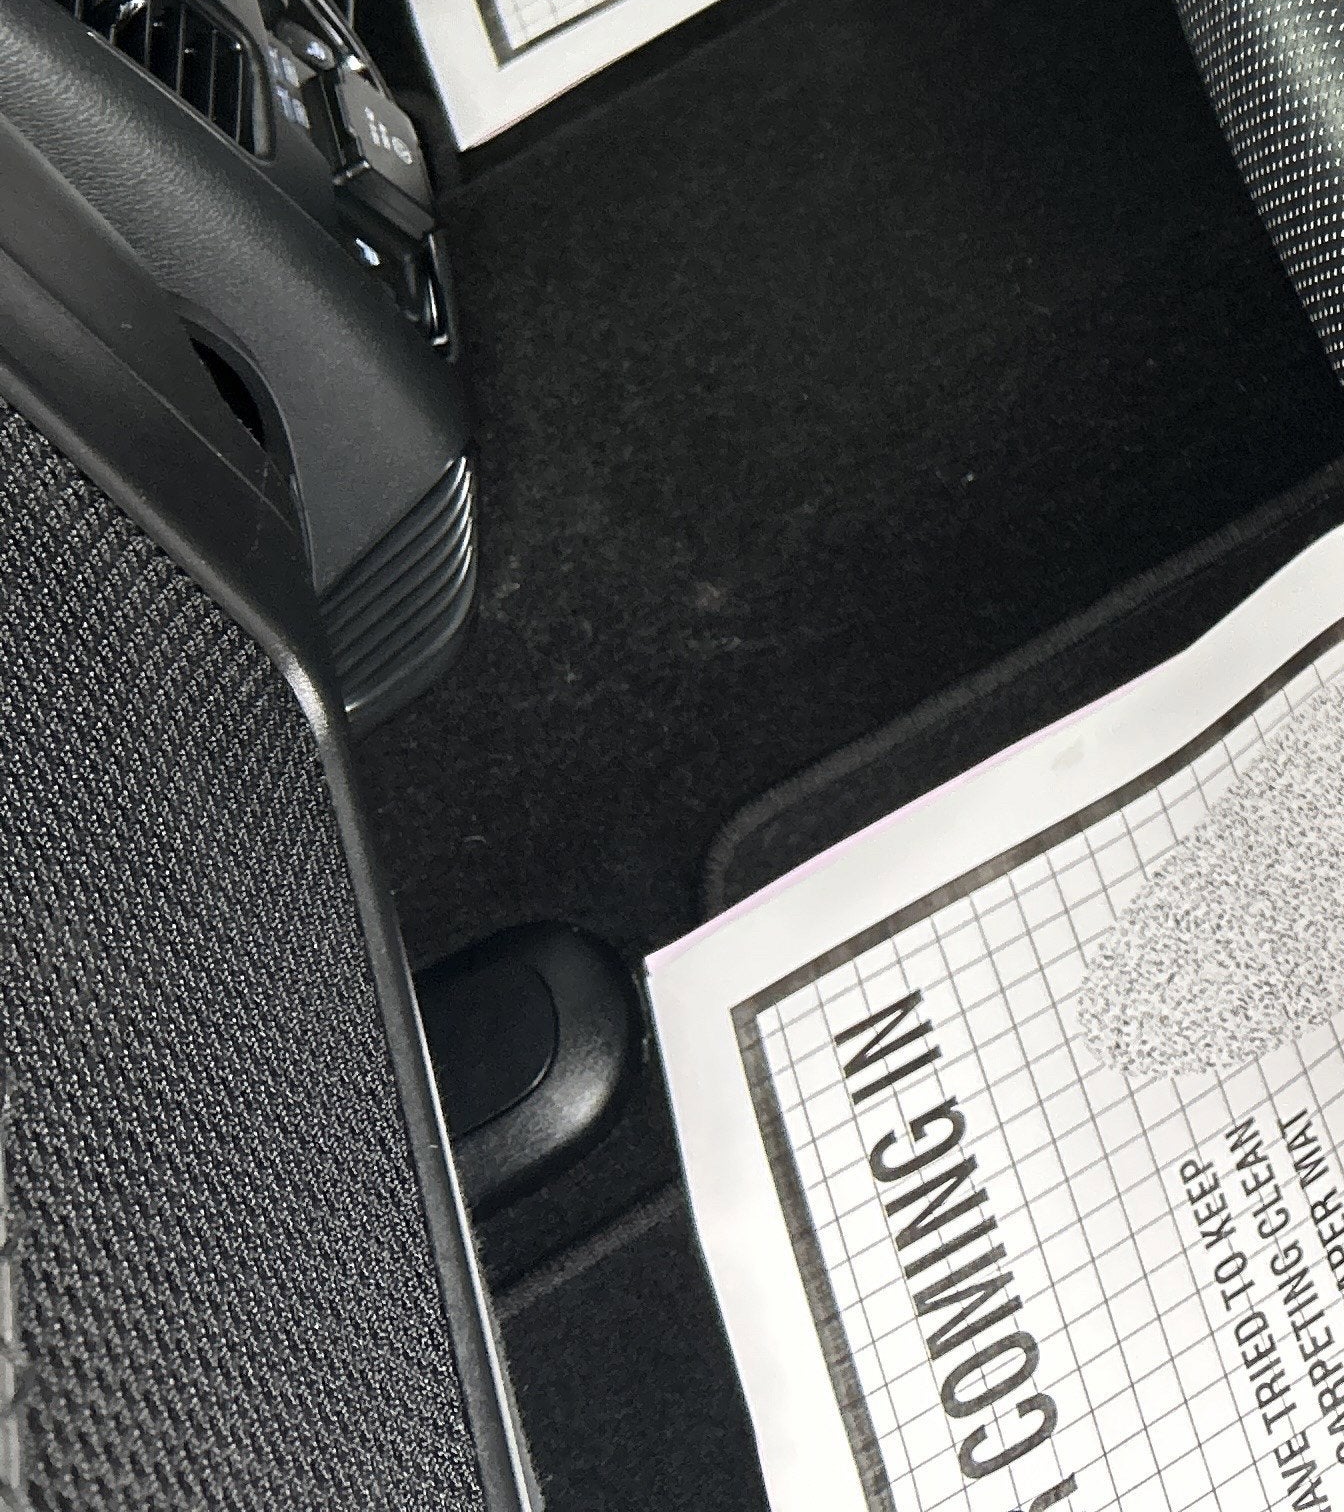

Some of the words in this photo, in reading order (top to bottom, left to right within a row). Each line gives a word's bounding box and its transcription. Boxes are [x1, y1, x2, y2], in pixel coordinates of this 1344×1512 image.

[834, 989, 942, 1105] IN
[1224, 1116, 1290, 1239] CLEAN
[1277, 1104, 1331, 1190] MAT
[1179, 1158, 1236, 1250] KEEP
[869, 1095, 1058, 1479] COMING
[1214, 1250, 1256, 1311] TO
[1234, 1311, 1297, 1435] TRIED
[1274, 1430, 1331, 1512] AVE
